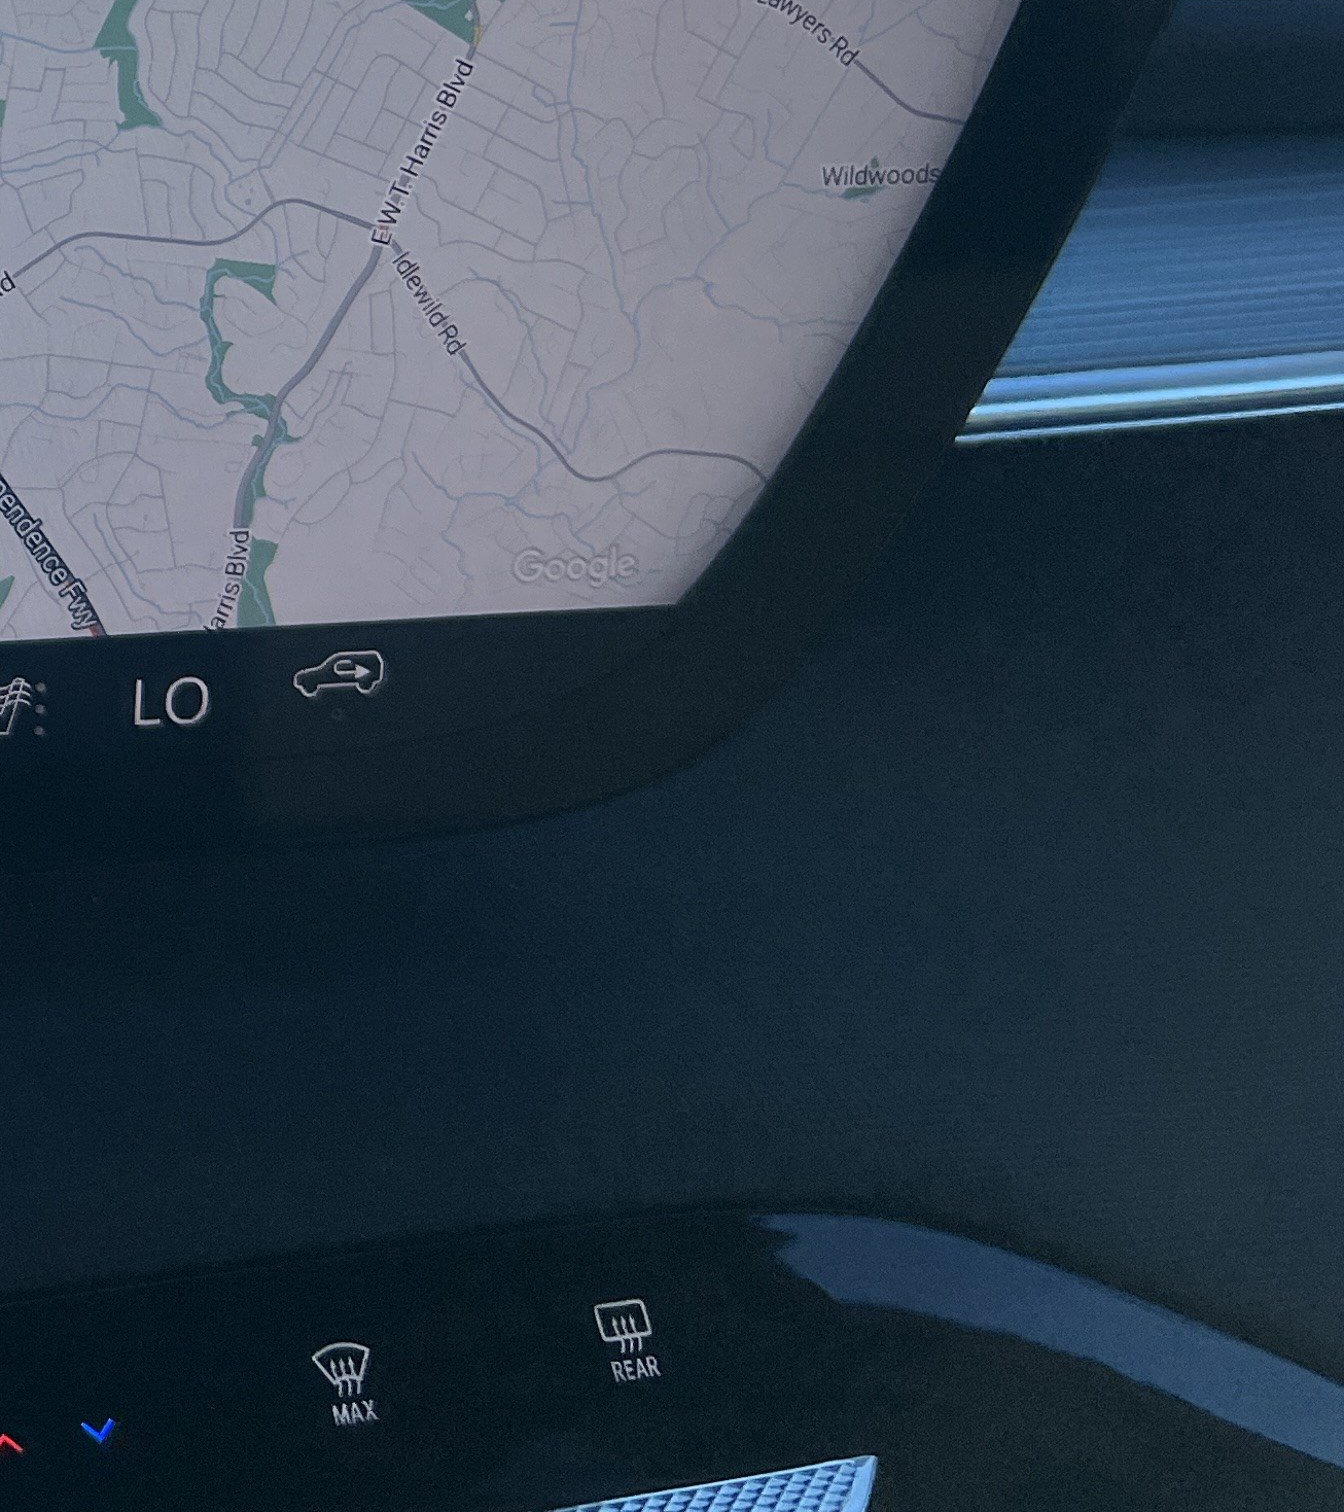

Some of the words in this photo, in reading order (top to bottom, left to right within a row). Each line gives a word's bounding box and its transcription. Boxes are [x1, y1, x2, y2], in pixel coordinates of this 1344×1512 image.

[827, 34, 859, 67] Rd
[399, 109, 448, 178] Harris
[436, 58, 475, 109] Blvd
[391, 250, 450, 331] Idlewild
[438, 322, 468, 357] Rd
[225, 530, 250, 576] Blvd
[513, 545, 639, 586] Google
[58, 580, 99, 632] Fwy
[133, 676, 212, 729] LO
[609, 1355, 662, 1383] REAR
[330, 1399, 380, 1427] MAX
